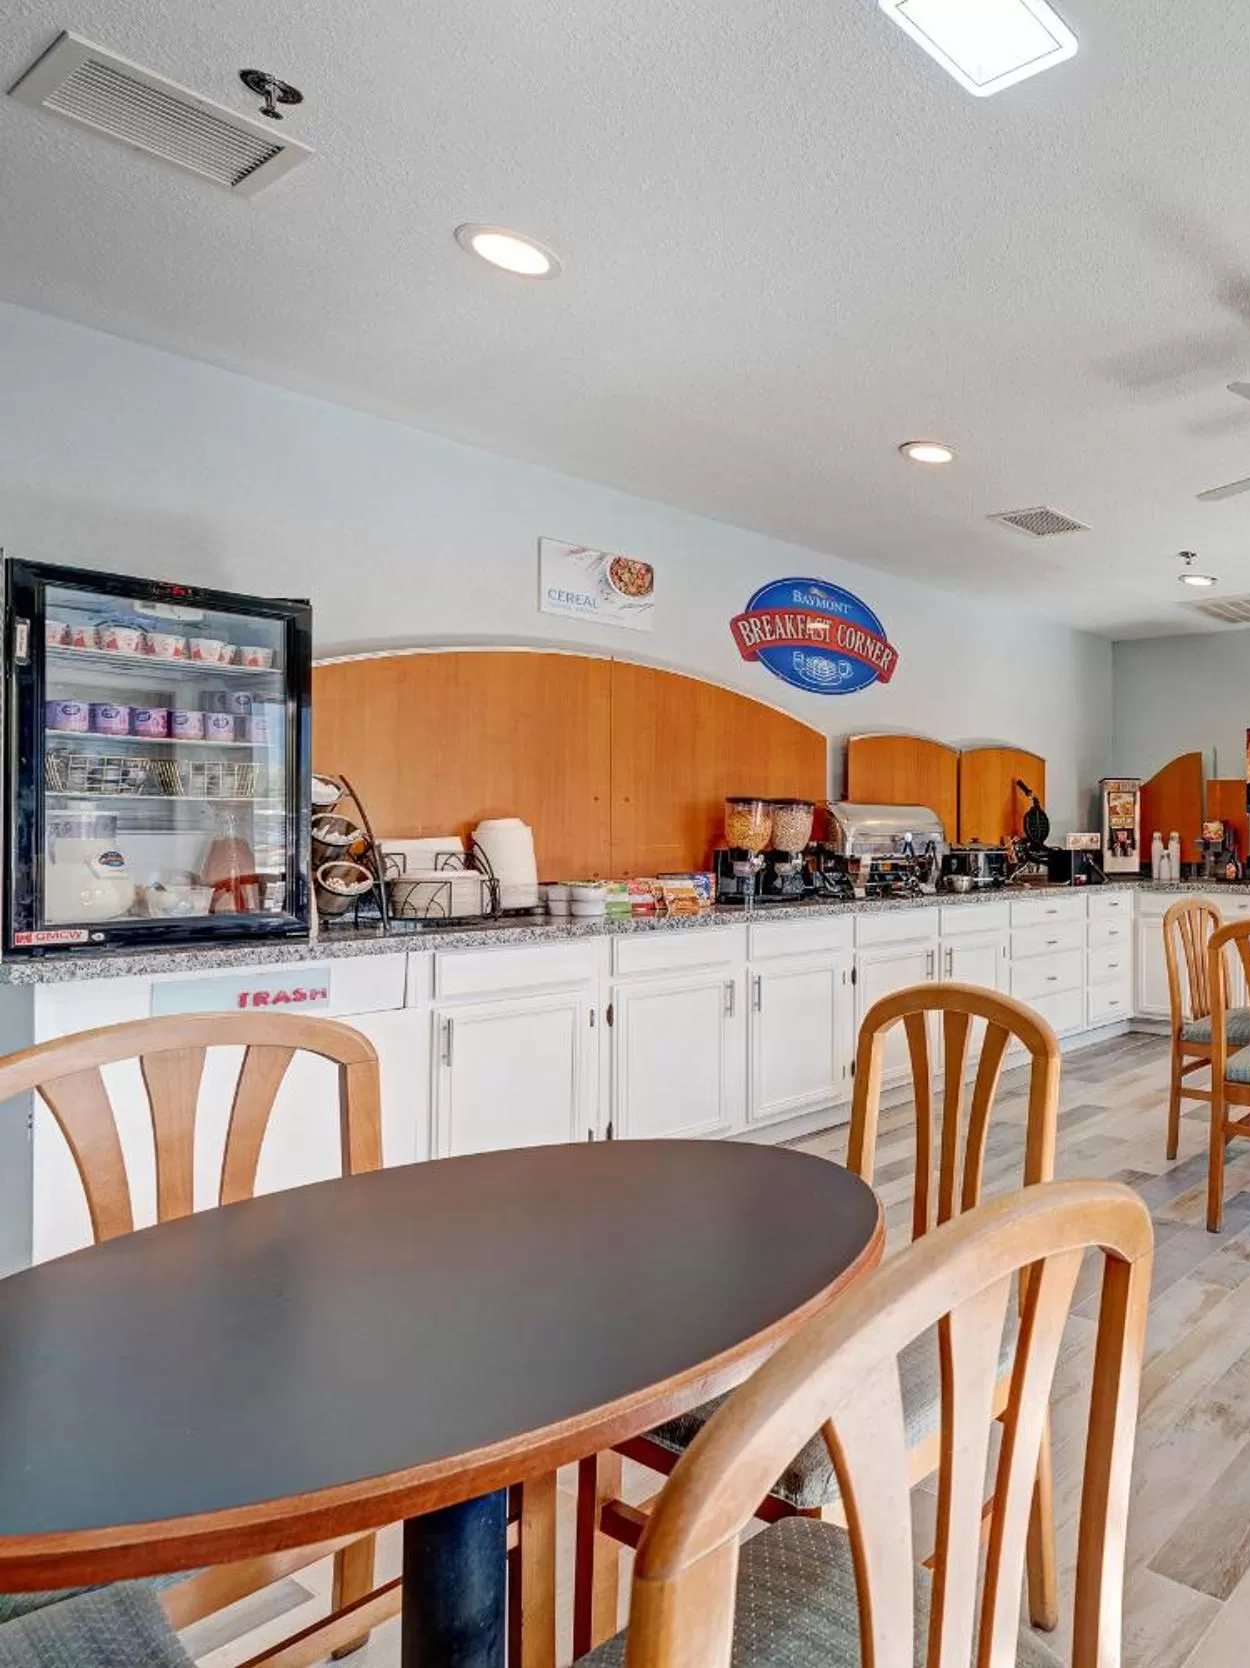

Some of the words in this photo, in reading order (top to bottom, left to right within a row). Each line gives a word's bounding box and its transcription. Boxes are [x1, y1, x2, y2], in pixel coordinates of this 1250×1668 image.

[547, 587, 600, 609] CEREAL
[792, 589, 852, 615] BAYMONT
[738, 613, 833, 647] BREAKFAST
[836, 624, 893, 672] CORNER
[237, 987, 328, 1009] TRASH
